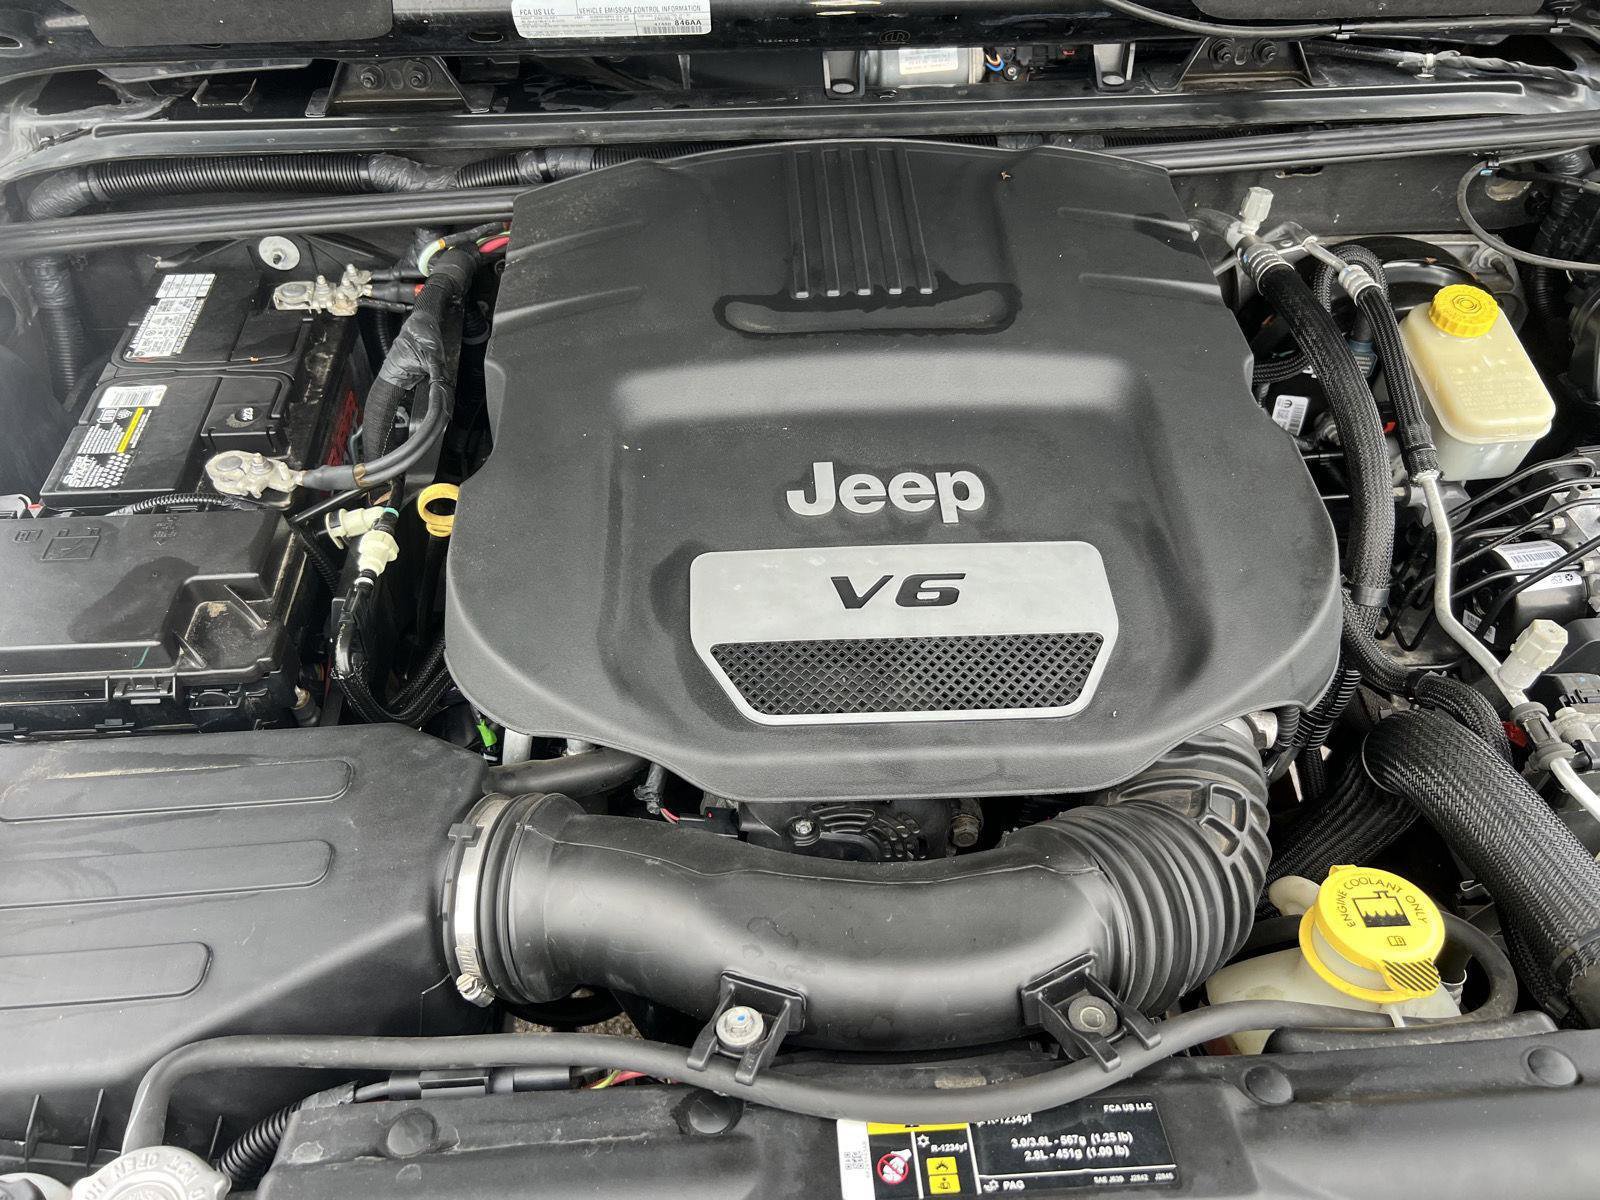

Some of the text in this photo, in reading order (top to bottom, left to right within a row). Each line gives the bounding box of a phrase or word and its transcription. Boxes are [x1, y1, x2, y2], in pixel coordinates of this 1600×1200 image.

[519, 8, 532, 16] FCA
[533, 8, 543, 16] US
[604, 6, 632, 14] EMISSION
[633, 5, 660, 13] CONTROL
[661, 5, 701, 13] INFORMATION
[786, 461, 986, 524] Jeep
[830, 572, 967, 610] V6
[1335, 876, 1427, 928] ENGINE COOLANT ONLY
[1103, 1102, 1153, 1113] FCA US LLC
[1060, 1134, 1087, 1147] 567g
[1090, 1132, 1117, 1145] (1.25
[1117, 1131, 1134, 1144] lb)
[930, 1143, 968, 1153] R-1234yf
[1113, 1145, 1131, 1158] lb)
[114, 1153, 160, 1178] OPEN
[167, 1155, 199, 1186] NOT
[1003, 1180, 1025, 1191] PAG
